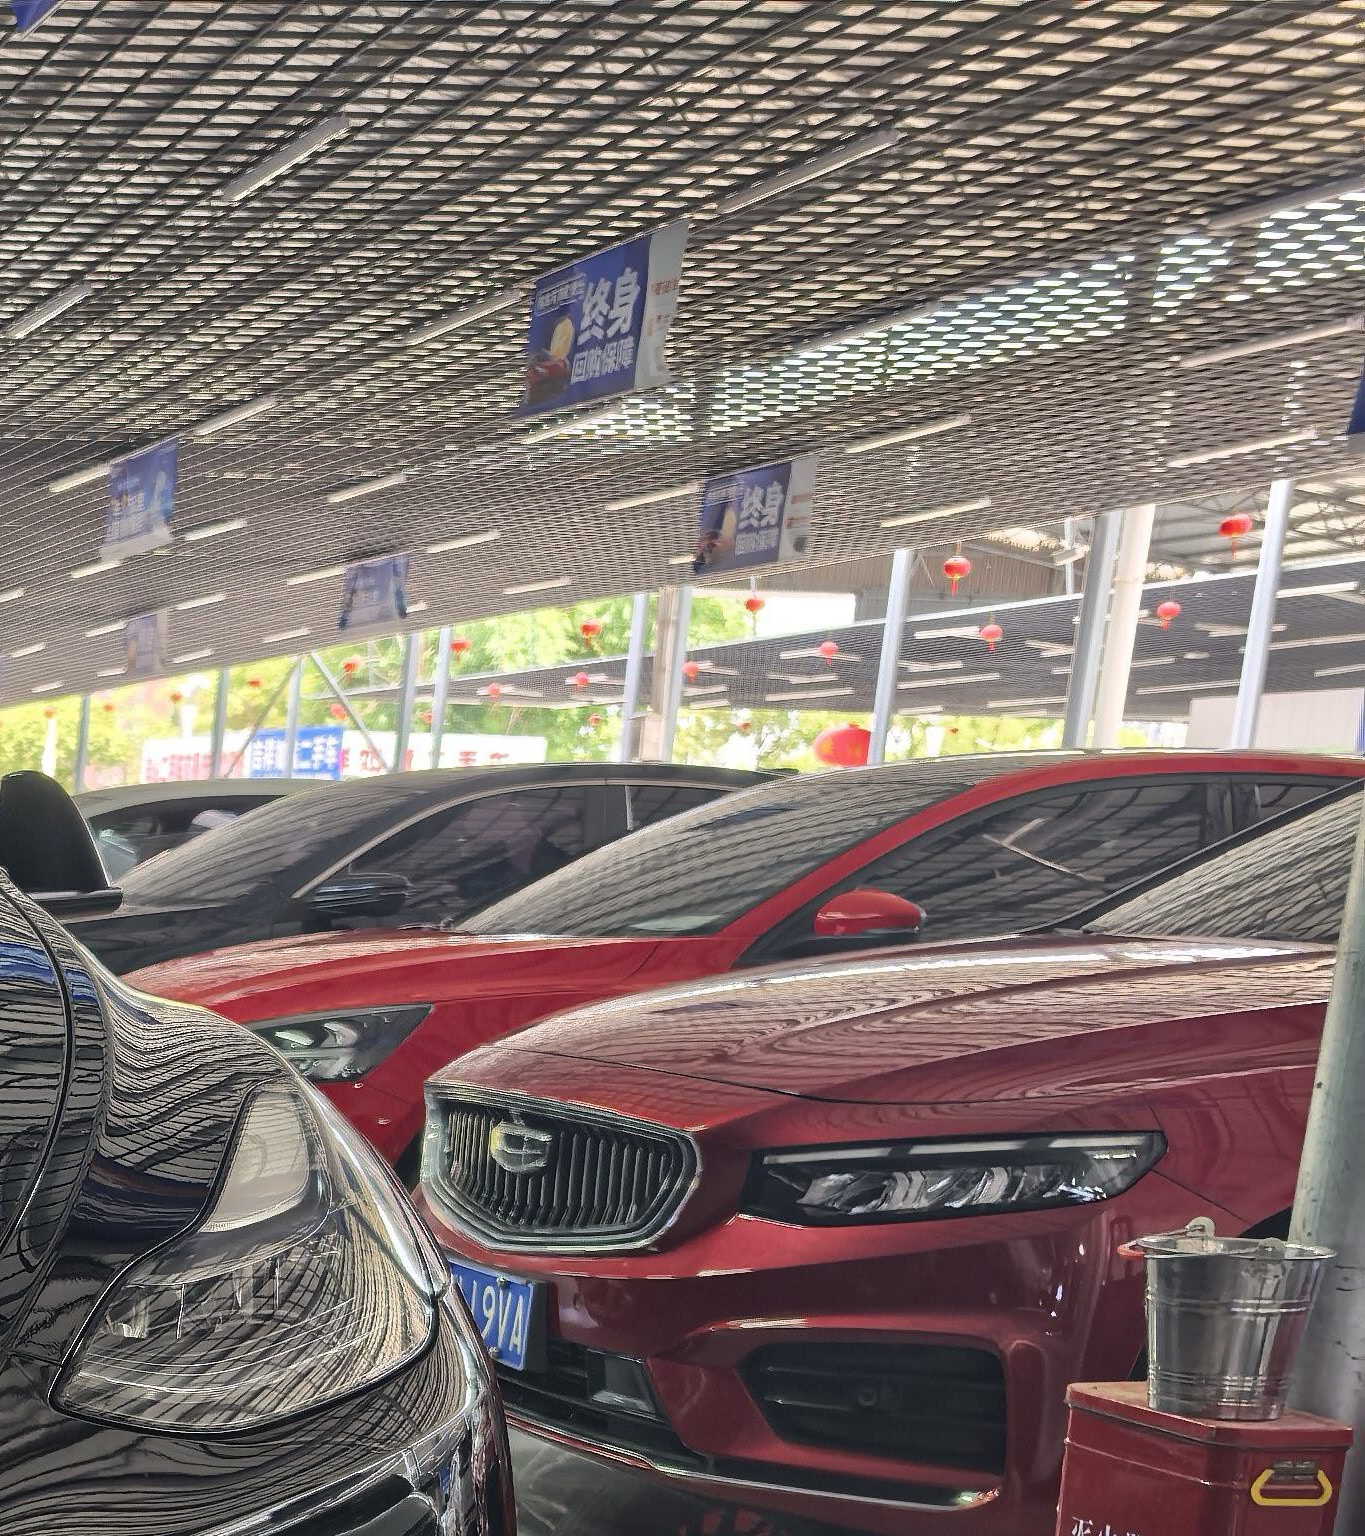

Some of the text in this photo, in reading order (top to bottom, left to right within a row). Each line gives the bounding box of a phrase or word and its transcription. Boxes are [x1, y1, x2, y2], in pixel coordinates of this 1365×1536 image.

[576, 267, 641, 346] 终身
[570, 336, 635, 384] 回购保障
[738, 481, 785, 531] 终身
